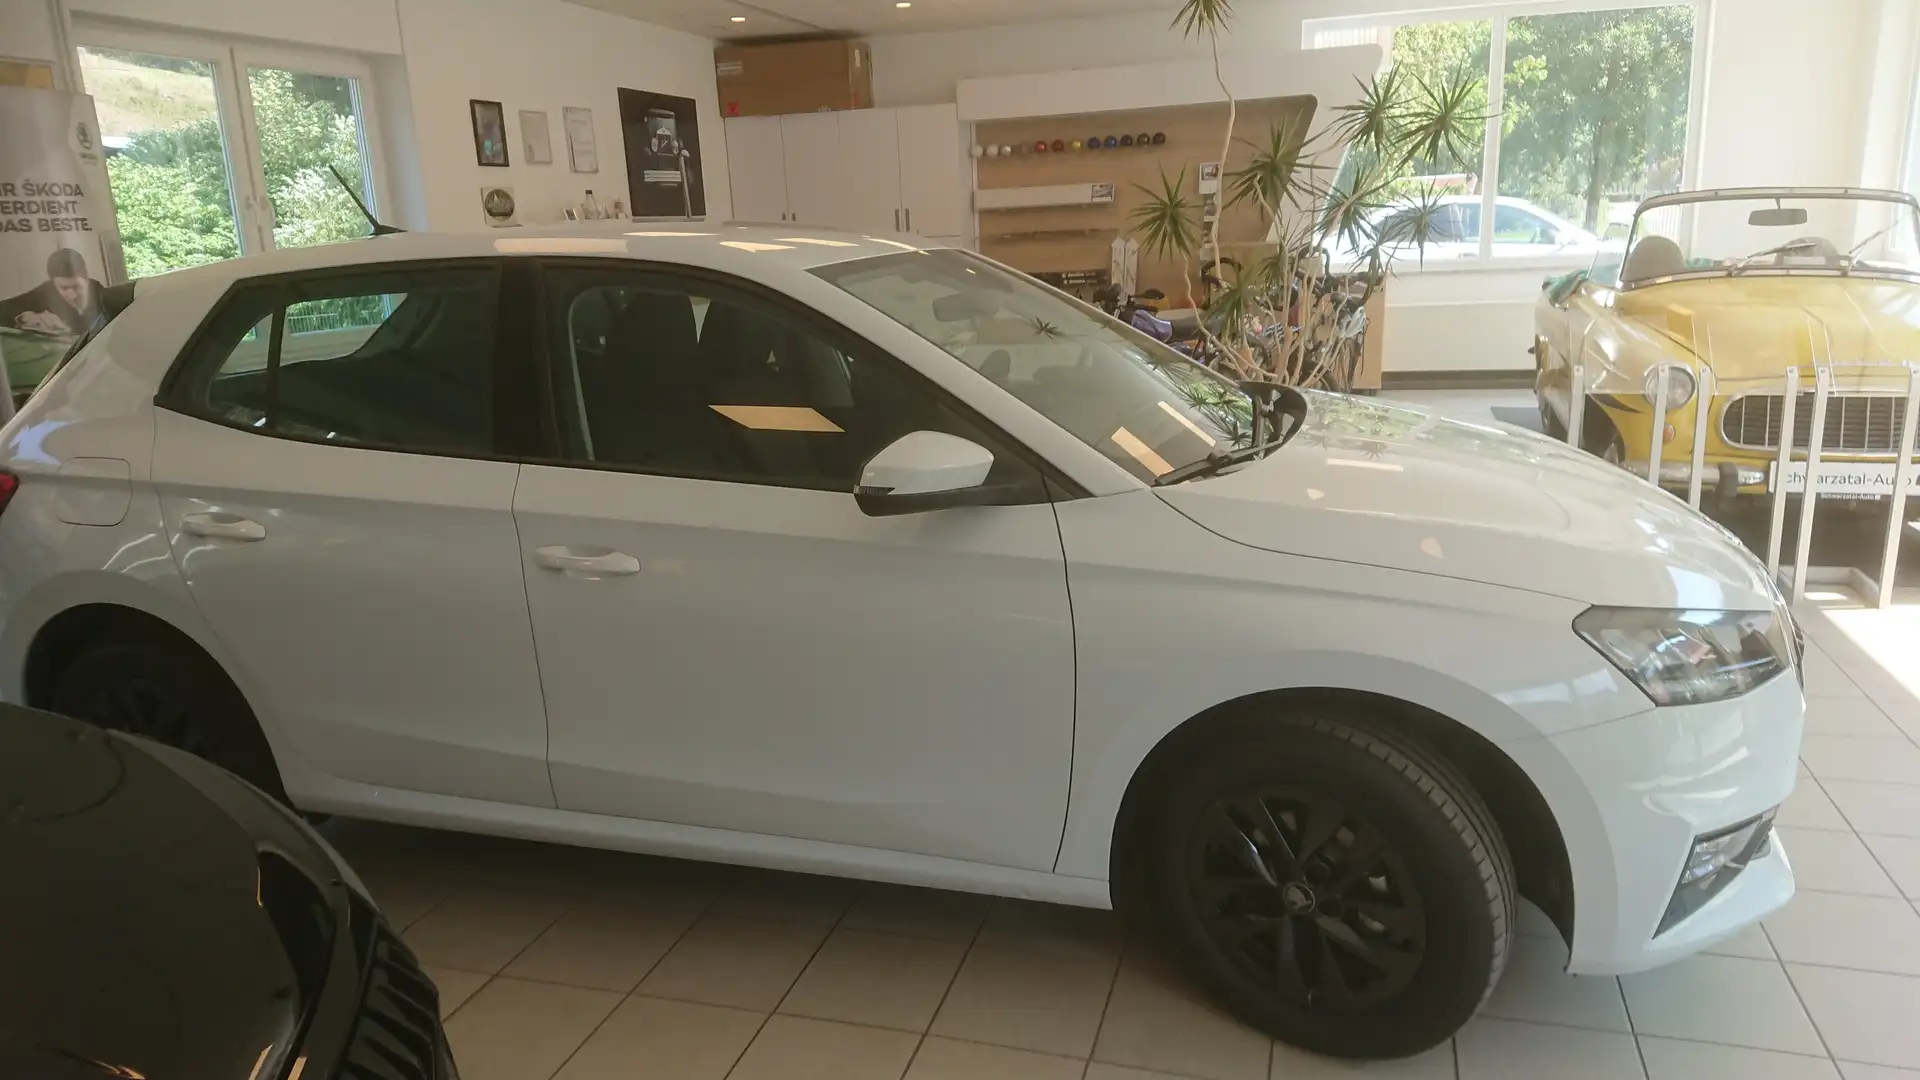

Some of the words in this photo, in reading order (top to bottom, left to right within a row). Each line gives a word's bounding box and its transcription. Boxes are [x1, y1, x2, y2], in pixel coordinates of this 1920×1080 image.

[22, 178, 84, 197] ŠKODA
[0, 218, 32, 232] AS
[38, 218, 92, 232] BESTE.
